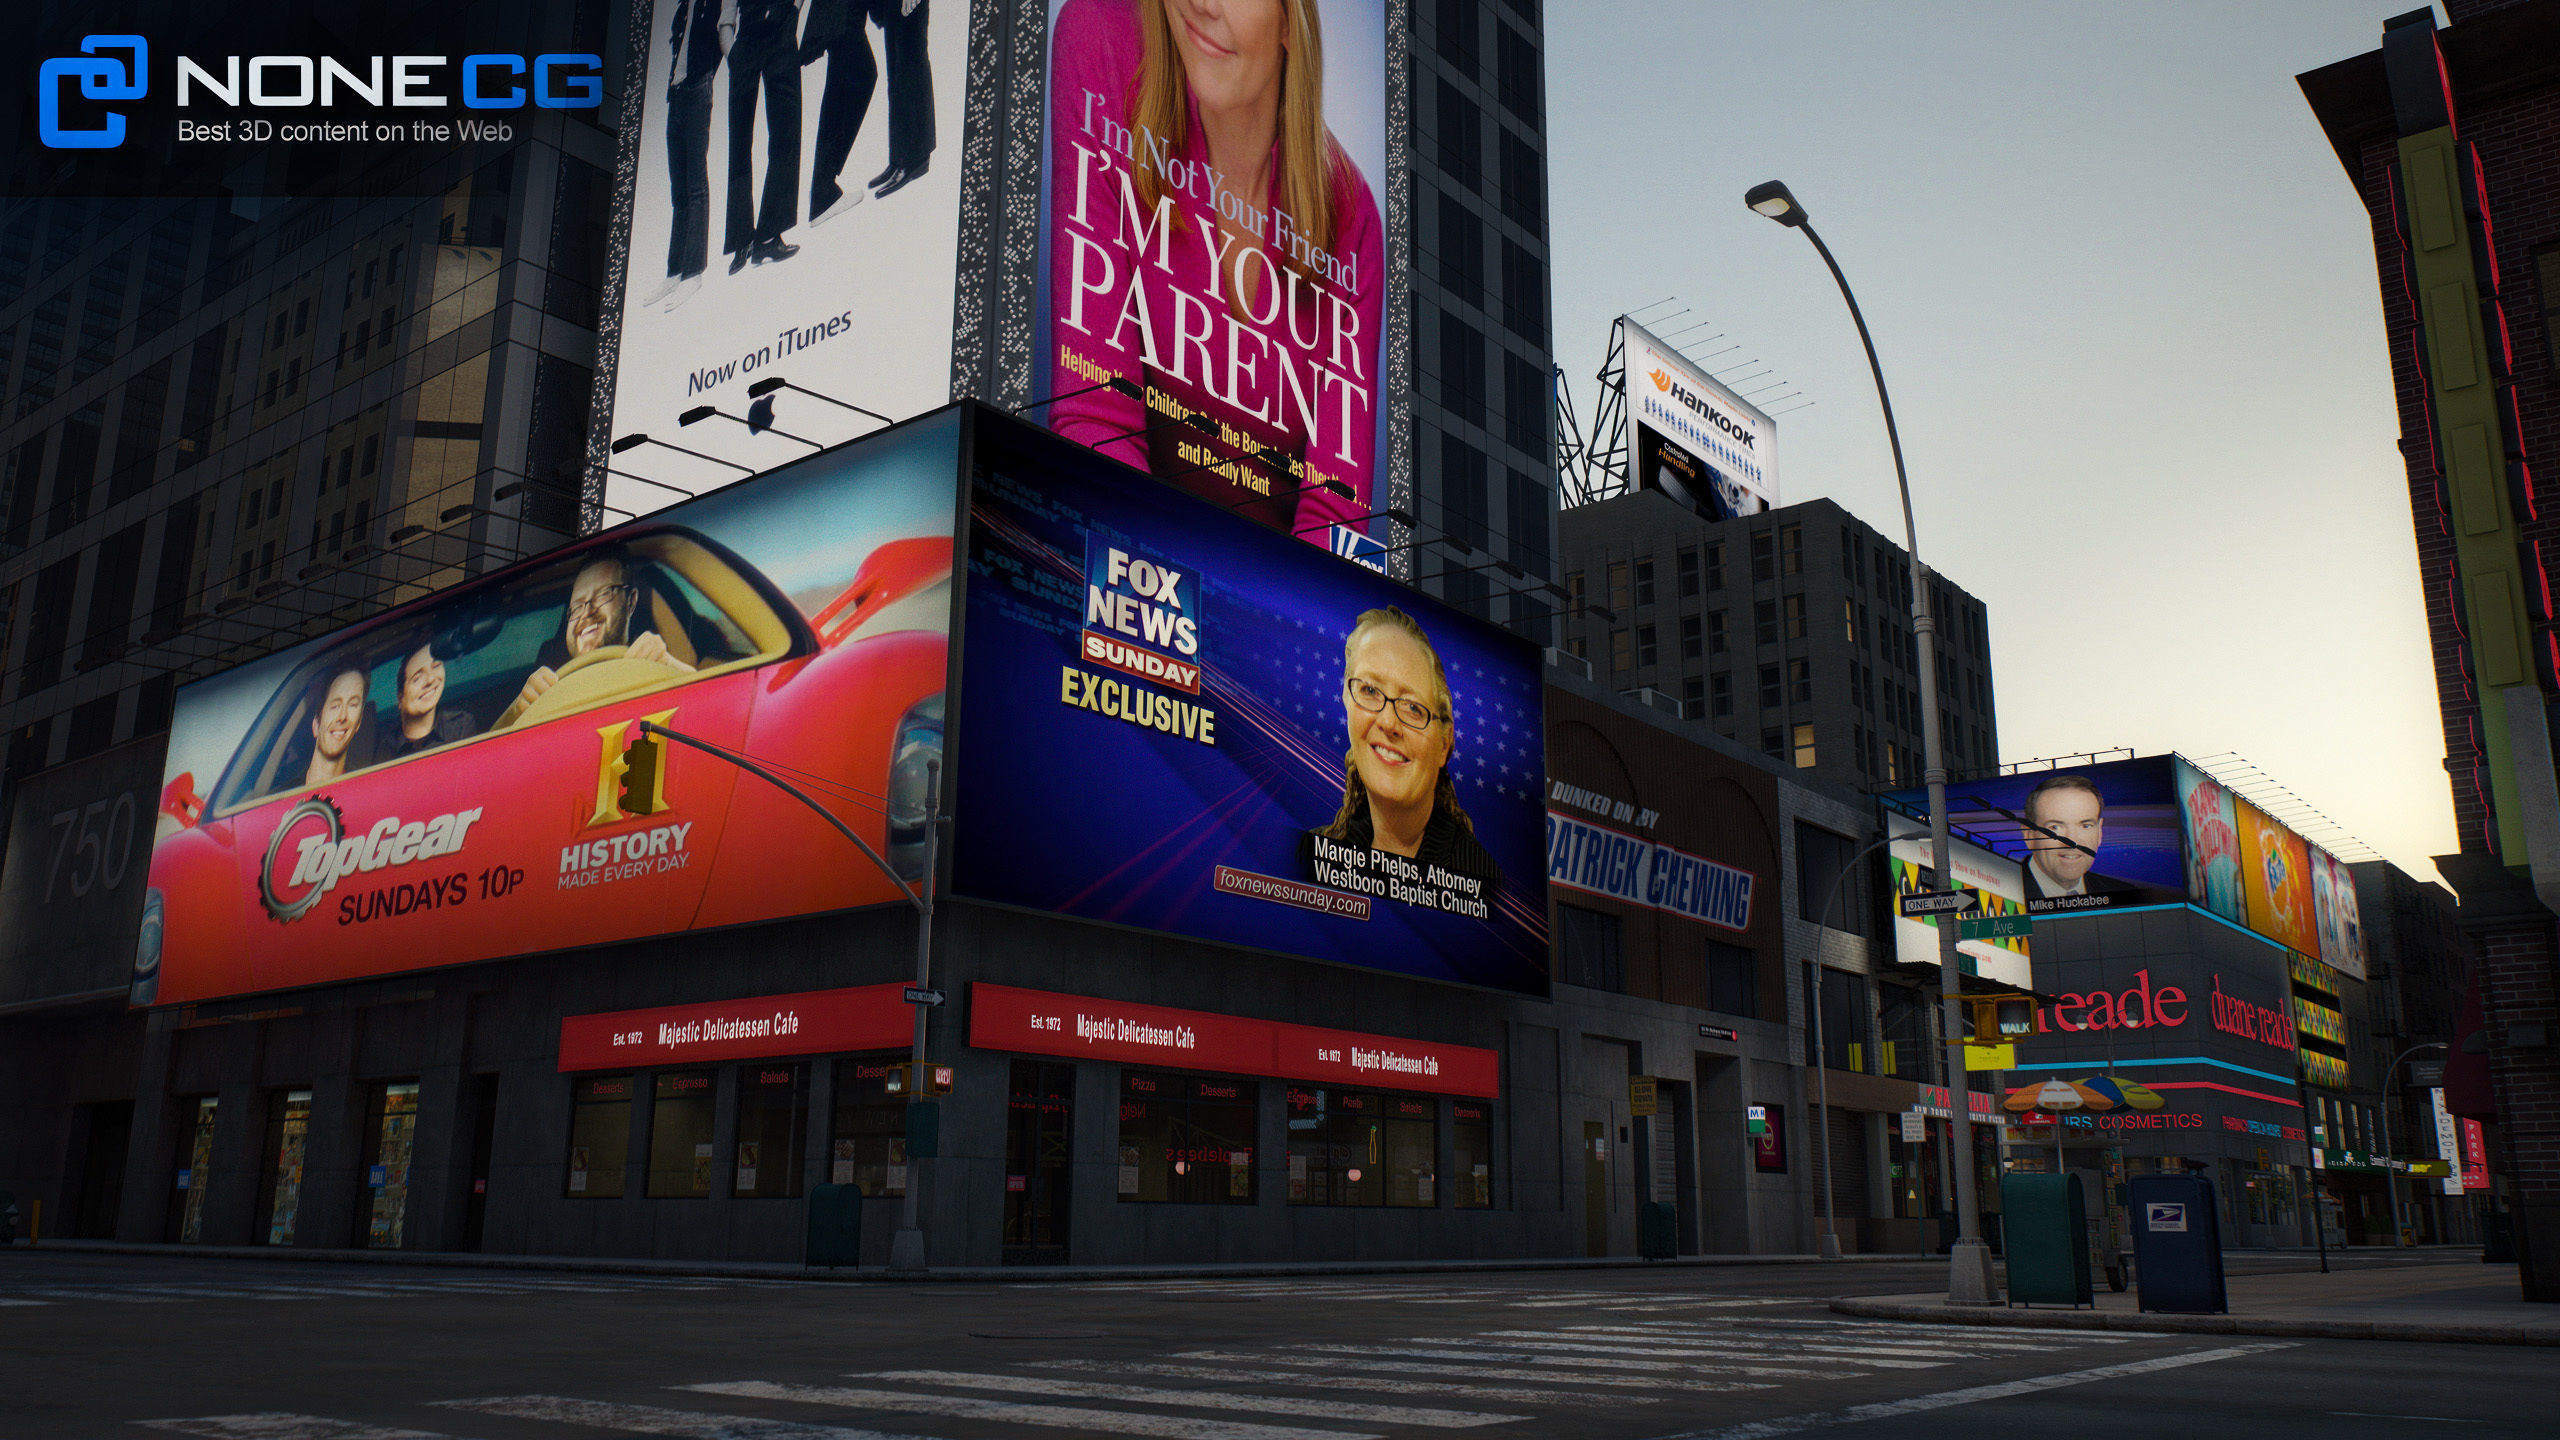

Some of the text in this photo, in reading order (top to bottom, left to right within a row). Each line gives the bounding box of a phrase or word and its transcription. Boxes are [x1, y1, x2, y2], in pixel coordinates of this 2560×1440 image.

[1080, 87, 1359, 296] I'm Not Your Friend
[1068, 140, 1365, 380] I'M YOUR
[688, 311, 852, 397] Now on iTunes
[1061, 227, 1368, 467] PARENT
[1061, 344, 1112, 392] Helping
[1146, 385, 1198, 429] Childre
[1221, 423, 1240, 449] the
[1178, 440, 1271, 497] and Really Want
[1108, 547, 1181, 609] FOX
[1089, 584, 1198, 655] NEWS
[1086, 636, 1197, 687] SUNDAY
[1061, 665, 1215, 745] EXCLUSIVE
[1551, 780, 1660, 830] DUNKED ON BY
[44, 791, 136, 903] 750
[288, 806, 483, 893] TopGear
[559, 821, 693, 874] HISTORY
[1314, 835, 1482, 899] Margie Phelps, Attorney
[337, 873, 468, 927] SUNDAYS
[557, 871, 599, 891] MADE
[604, 861, 654, 883] EVERY
[1220, 868, 1367, 916] foxnewssunday.com
[1314, 860, 1489, 919] Westboro Baptist Church
[1646, 846, 1751, 928] CHEWING
[1908, 898, 1955, 910] ONE WAY
[1971, 920, 2015, 936] 7 Ave
[2029, 896, 2109, 911] Mike Huckabee
[627, 1031, 643, 1045] 1972
[658, 1021, 700, 1050] Majestic
[703, 1014, 770, 1042] Delicatessen
[773, 1010, 799, 1035] Cafe
[1046, 1016, 1061, 1031] 1972
[1077, 1013, 1115, 1043] Majestic
[1118, 1018, 1173, 1048] Delicatessen
[1176, 1025, 1195, 1049] Cafe
[2000, 1022, 2031, 1034] WALK
[2212, 973, 2295, 1051] duane reade
[760, 1070, 790, 1085] Salads
[856, 1065, 886, 1080] Desse
[1131, 1077, 1157, 1093] Pizza
[1351, 1047, 1380, 1072] Majestic
[1382, 1051, 1422, 1075] Delicatessen
[1424, 1056, 1439, 1076] Cafe
[1200, 1083, 1237, 1098] Desserts
[2100, 1113, 2203, 1130] COSMETICS
[2468, 1123, 2480, 1159] PARK
